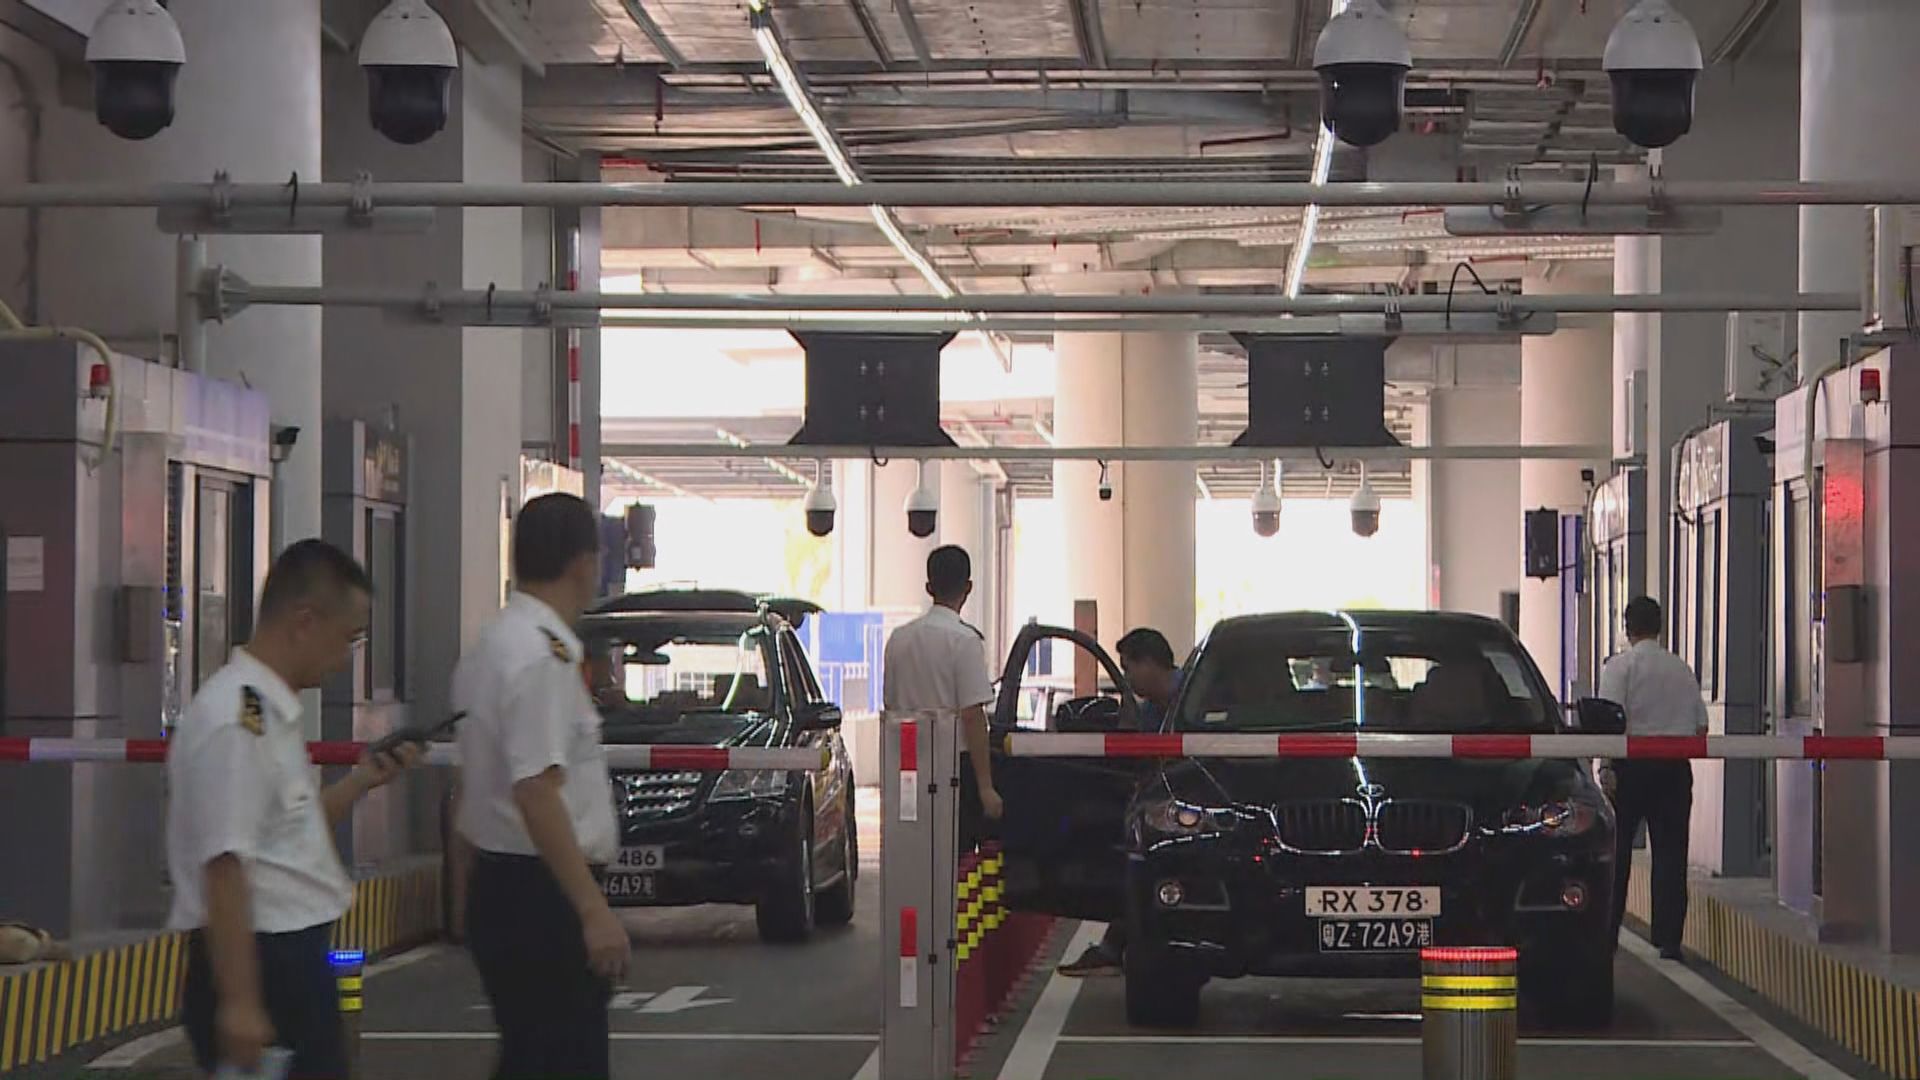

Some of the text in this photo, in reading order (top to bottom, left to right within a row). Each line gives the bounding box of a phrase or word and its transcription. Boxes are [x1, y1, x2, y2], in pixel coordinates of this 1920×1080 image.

[617, 849, 657, 867] 486
[1322, 890, 1422, 912] RX 378
